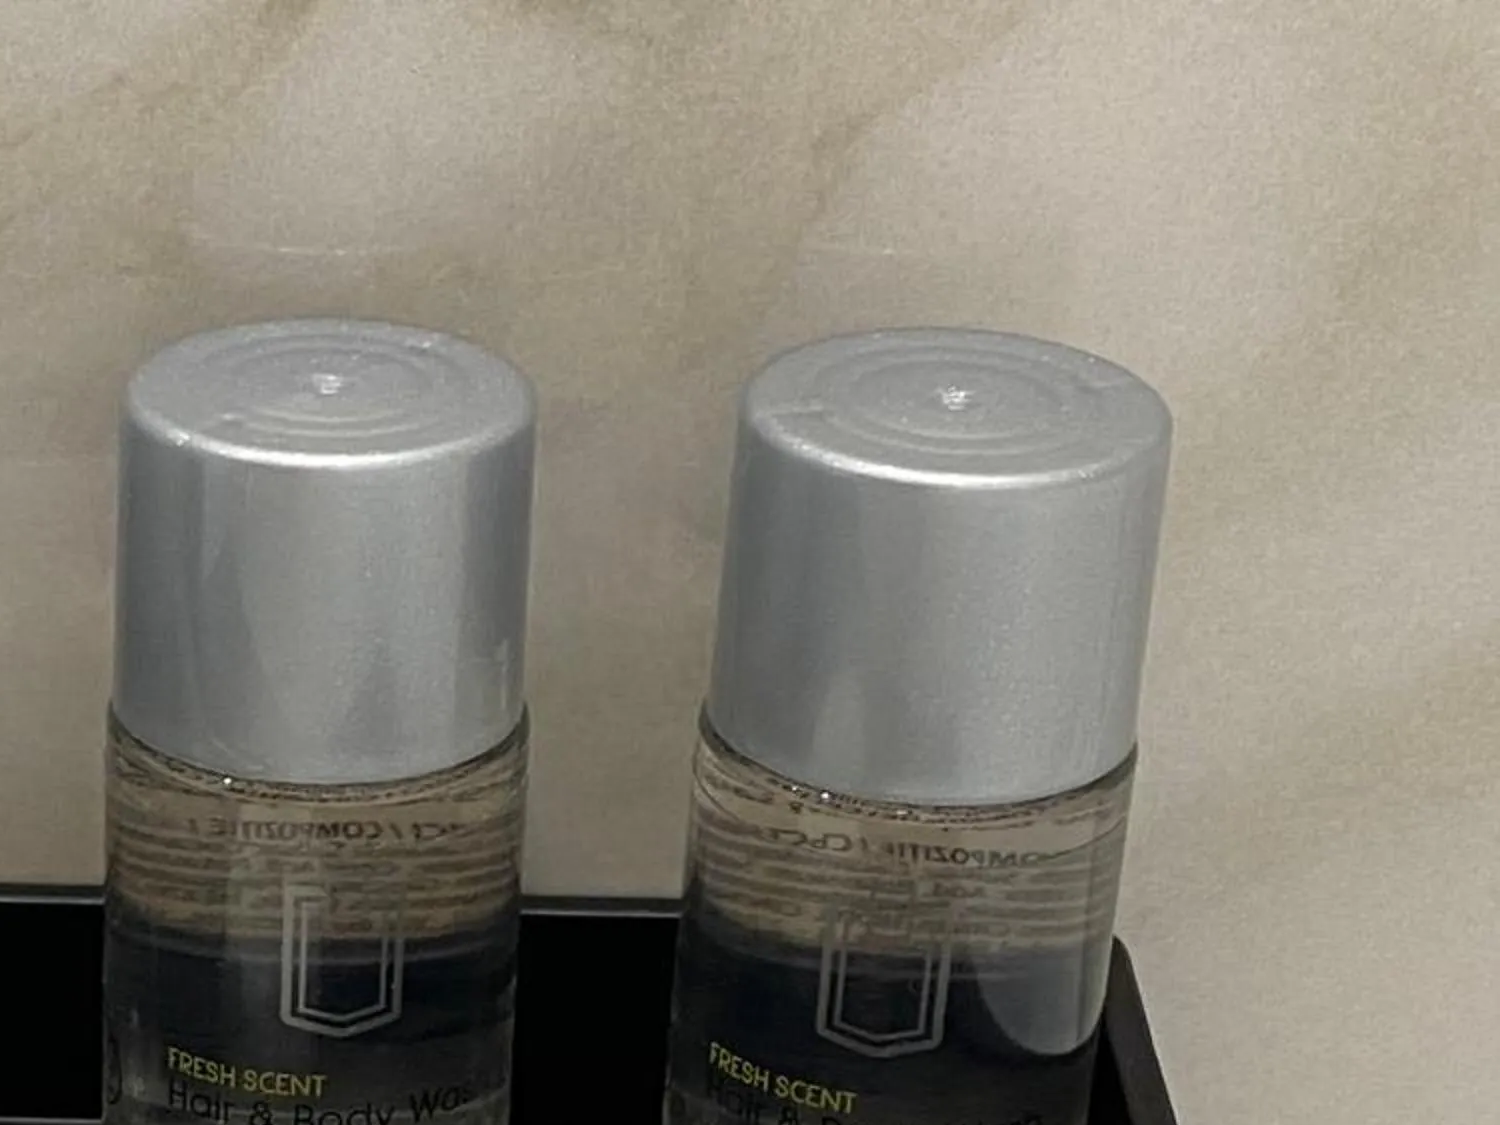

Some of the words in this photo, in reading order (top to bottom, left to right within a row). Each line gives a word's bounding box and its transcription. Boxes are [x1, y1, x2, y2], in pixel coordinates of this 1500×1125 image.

[167, 1046, 237, 1089] FRESH
[242, 1068, 329, 1099] SCENT
[708, 1041, 770, 1093] FRESH
[774, 1075, 859, 1115] SCENT
[168, 1076, 235, 1125] Hair
[408, 1081, 478, 1123] Was
